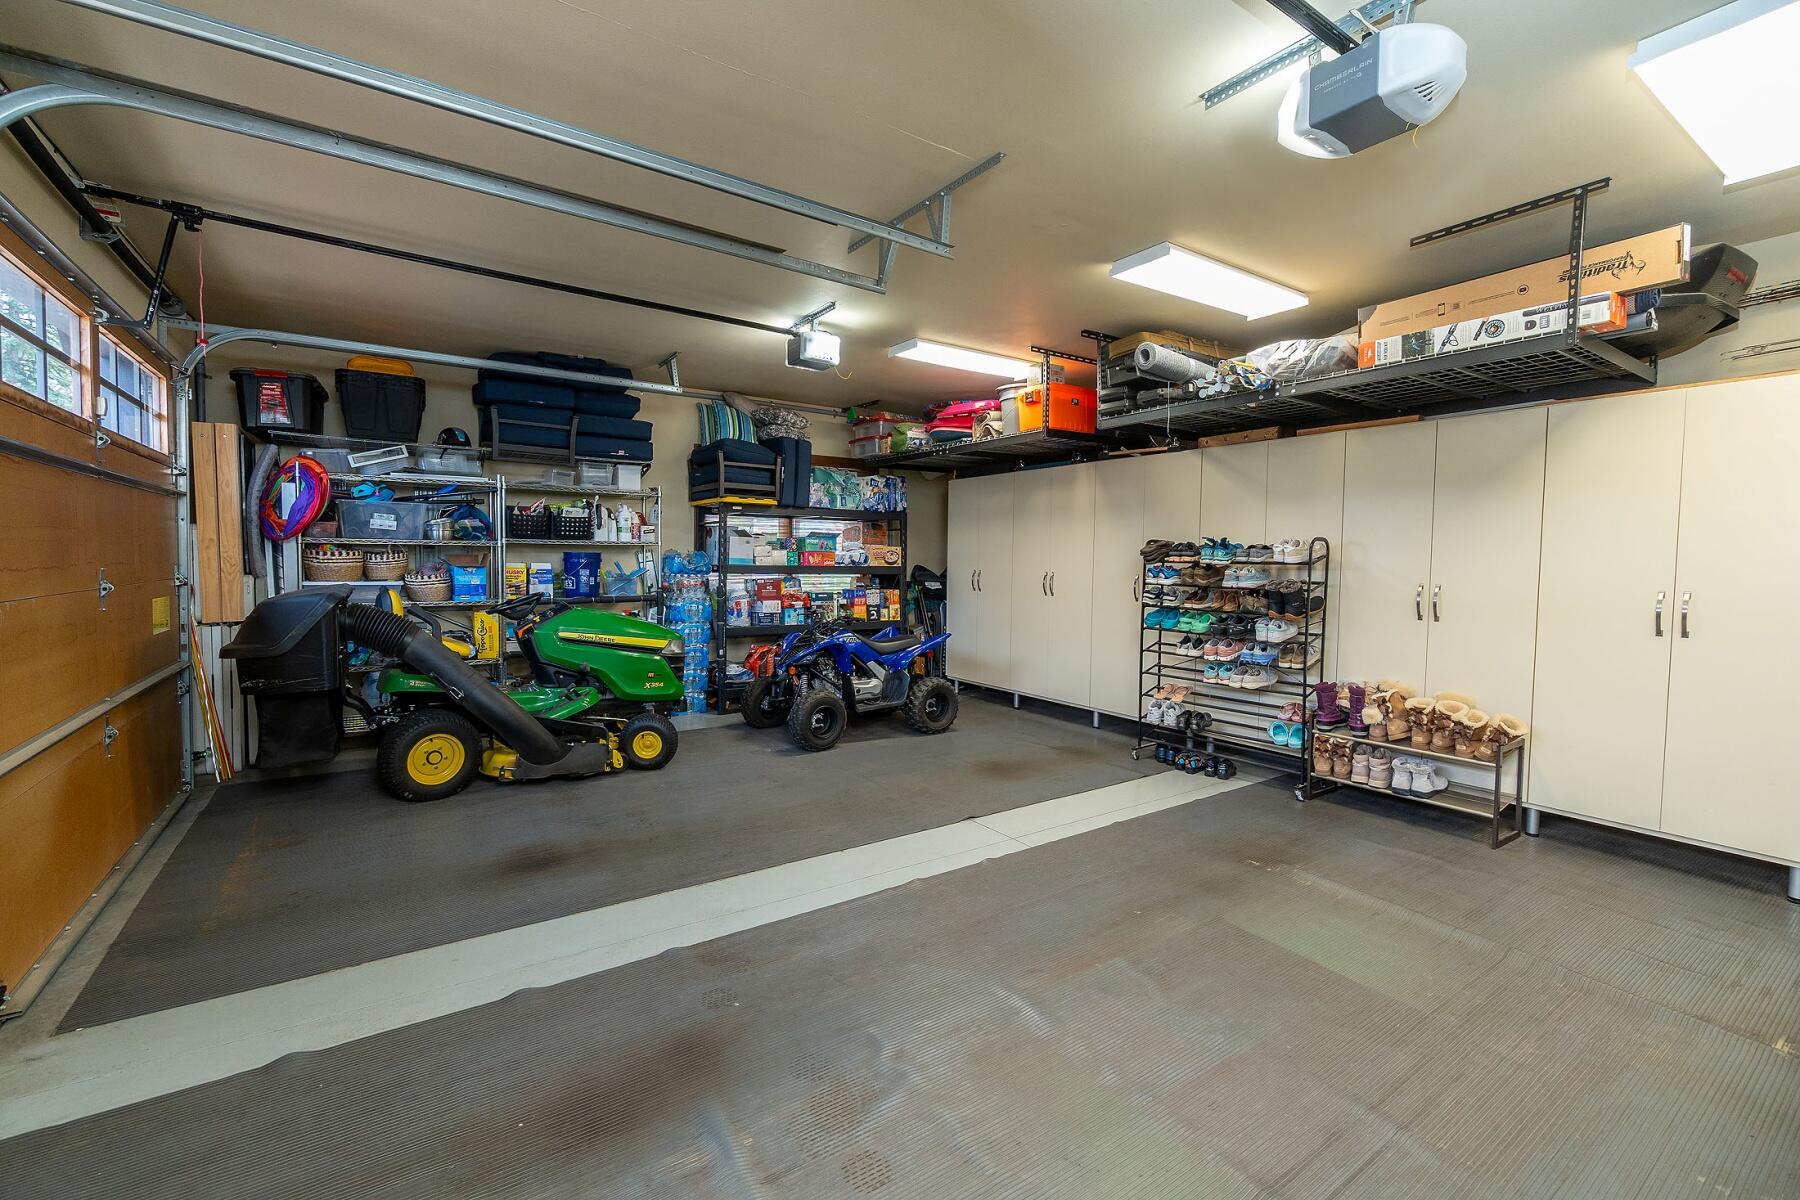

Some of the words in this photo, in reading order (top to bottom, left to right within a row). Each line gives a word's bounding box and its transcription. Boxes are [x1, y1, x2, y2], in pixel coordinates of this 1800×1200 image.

[1314, 58, 1373, 91] CHAMBERLAIN
[1557, 259, 1629, 283] Traditis
[476, 617, 488, 636] Chico
[477, 636, 488, 654] Topo
[576, 633, 594, 641] JOHN
[594, 635, 616, 643] DEERE
